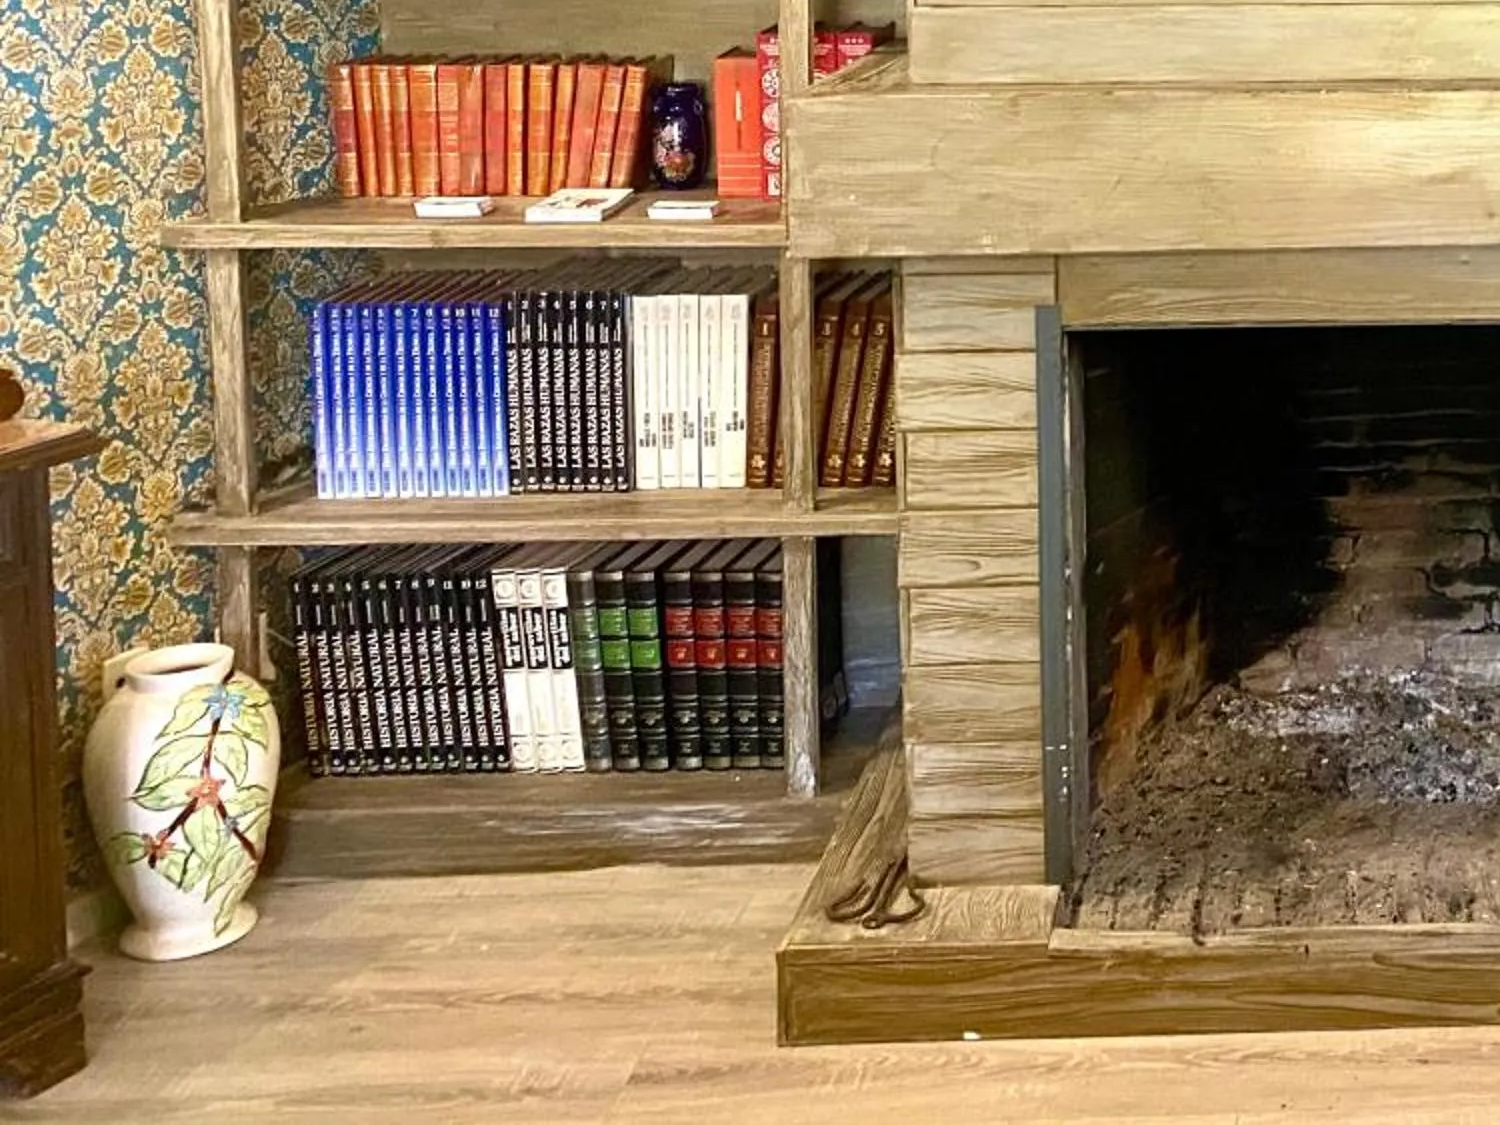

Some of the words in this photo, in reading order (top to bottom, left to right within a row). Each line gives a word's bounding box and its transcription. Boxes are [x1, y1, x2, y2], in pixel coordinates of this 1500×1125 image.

[507, 349, 519, 405] HUMANAS
[522, 348, 533, 405] HUMANAS
[539, 347, 550, 403] HUMANAS
[553, 348, 565, 405] HUMANAS
[569, 348, 580, 405] HUMANAS
[585, 348, 597, 405] HUMANAS
[599, 349, 610, 405] HUMANAS
[508, 409, 520, 445] RAZAS
[523, 407, 534, 443] RAZAS
[540, 406, 551, 443] RAZAS
[555, 407, 566, 443] RAZAS
[570, 407, 581, 443] RAZAS
[586, 406, 598, 443] RAZAS
[600, 408, 611, 444] RAZAS
[509, 446, 520, 469] LAS
[524, 446, 534, 467] LAS
[541, 445, 552, 466] LAS
[555, 446, 566, 467] LAS
[571, 446, 581, 467] LAS
[587, 446, 598, 467] LAS
[601, 446, 611, 468] LAS
[316, 630, 333, 688] NATURAL
[331, 631, 348, 688] NATURAL
[349, 630, 366, 688] NATURAL
[366, 628, 384, 686] NATURAL
[382, 628, 400, 686] NATURAL
[398, 628, 415, 685] NATURAL
[415, 627, 433, 685] NATURAL
[431, 626, 447, 683] NATURAL
[448, 628, 465, 685] NATURAL
[465, 627, 482, 685] NATURAL
[481, 626, 498, 685] NATURAL
[323, 692, 339, 749] HISTORIA
[338, 692, 355, 749] HISTORIA
[355, 691, 373, 749] HISTORIA
[373, 689, 391, 747] HISTORIA
[389, 689, 407, 747] HISTORIA
[405, 689, 422, 747] HISTORIA
[422, 688, 440, 745] HISTORIA
[437, 686, 454, 744] HISTORIA
[455, 688, 472, 745] HISTORIA
[471, 687, 488, 745] HISTORIA
[487, 687, 504, 745] HISTORIA
